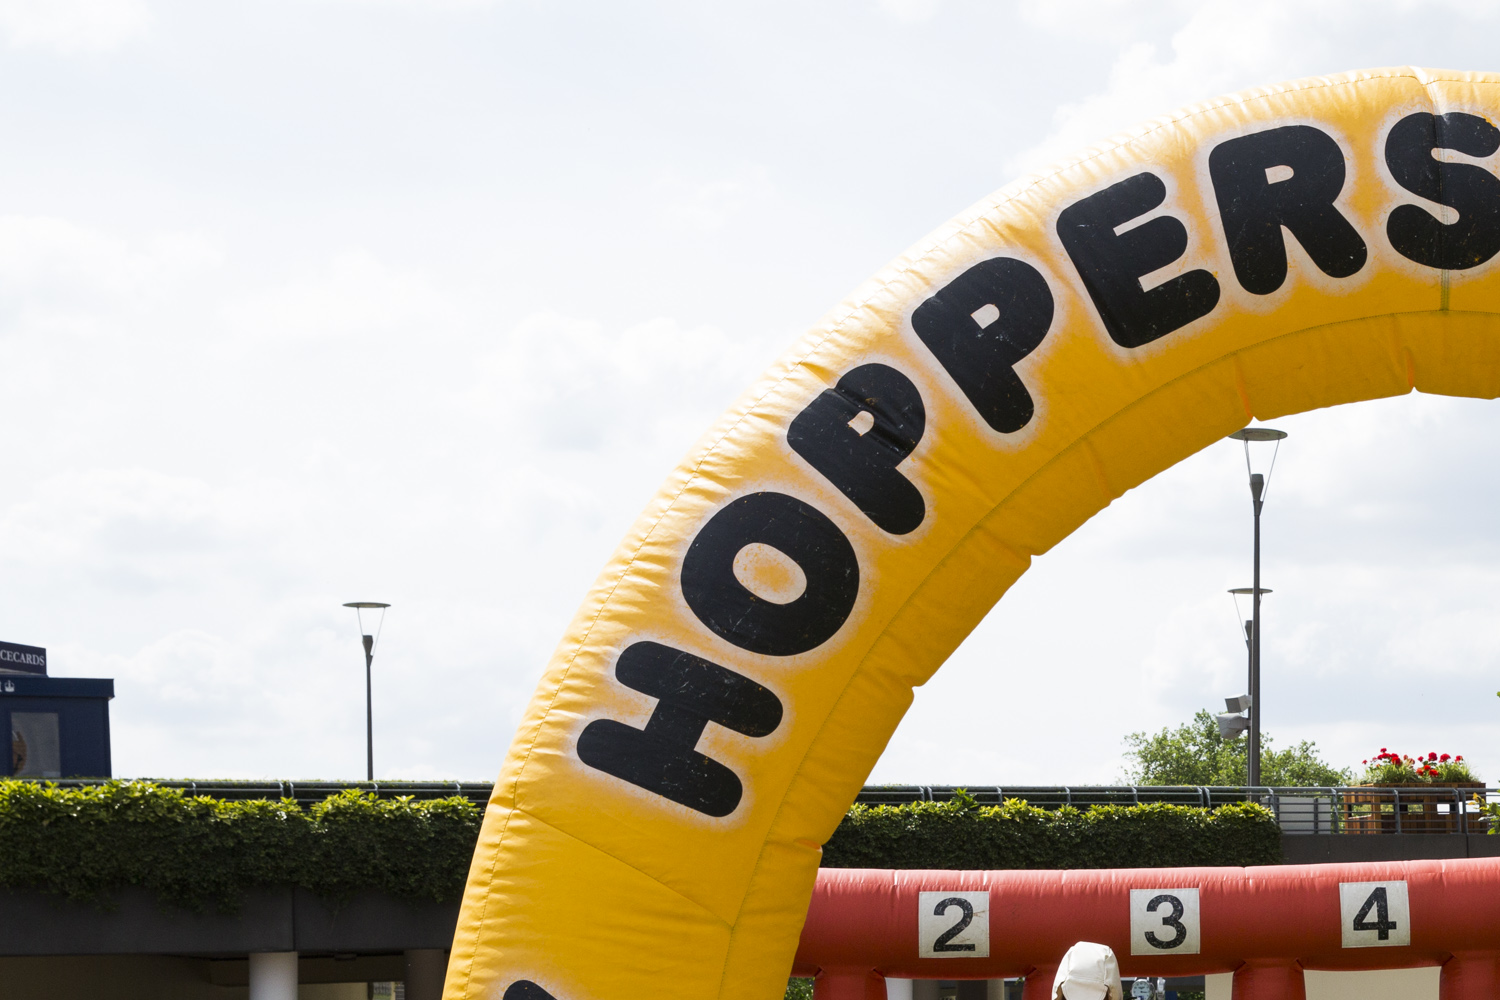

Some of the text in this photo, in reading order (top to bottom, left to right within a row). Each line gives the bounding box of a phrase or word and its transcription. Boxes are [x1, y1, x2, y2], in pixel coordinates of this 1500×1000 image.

[933, 898, 975, 952] 2
[1145, 895, 1186, 949] 3
[1353, 888, 1396, 940] 4
